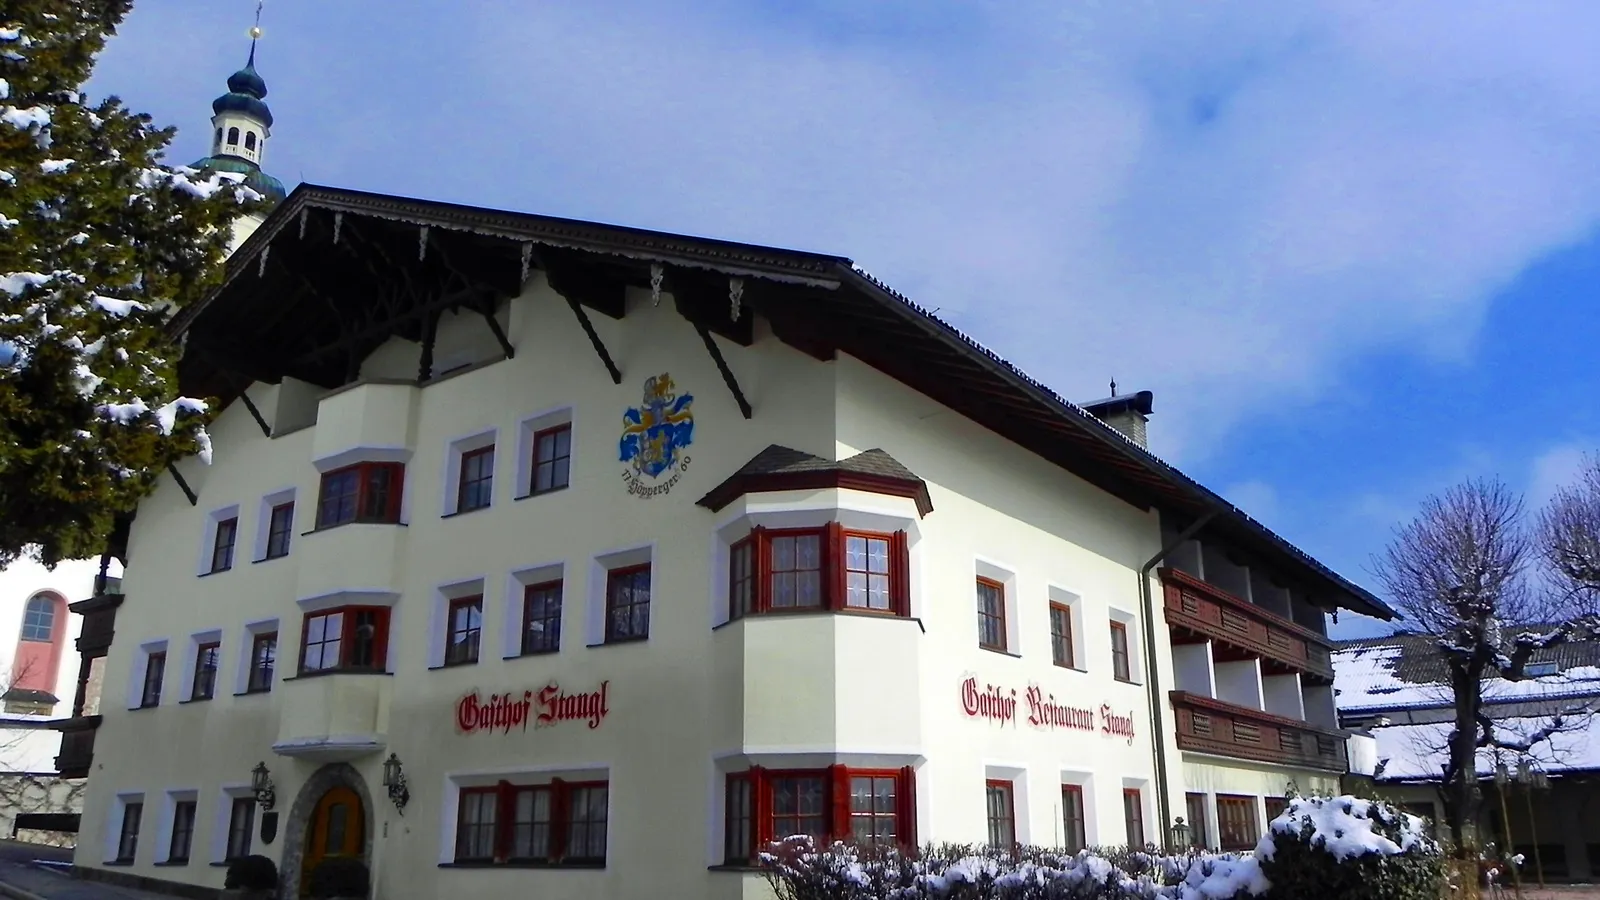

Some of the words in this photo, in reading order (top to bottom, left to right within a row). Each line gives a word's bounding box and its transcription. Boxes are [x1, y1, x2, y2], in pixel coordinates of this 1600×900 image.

[680, 455, 692, 472] 60
[536, 680, 610, 729] Stangl
[1100, 703, 1135, 747] Stangl
